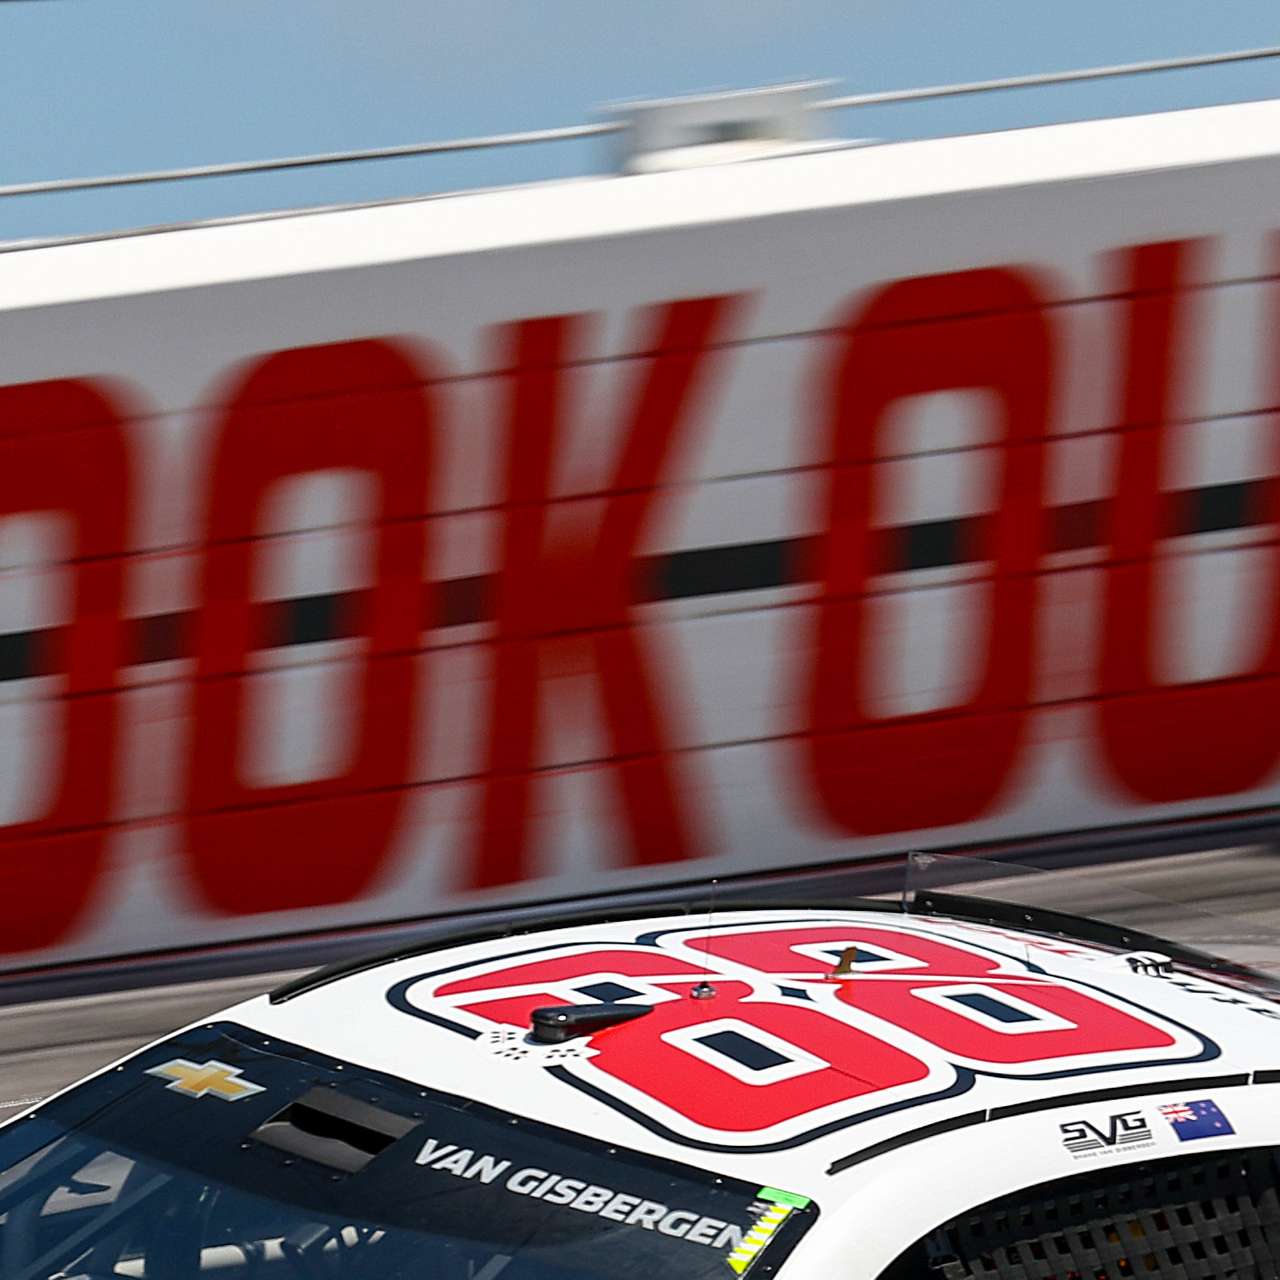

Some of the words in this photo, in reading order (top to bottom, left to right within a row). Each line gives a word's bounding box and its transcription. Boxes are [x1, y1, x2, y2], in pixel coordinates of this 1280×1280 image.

[410, 922, 1200, 1140] 88
[1059, 1110, 1148, 1146] SVG
[414, 1138, 511, 1185] VAN
[505, 1167, 745, 1252] GISBERGEN
